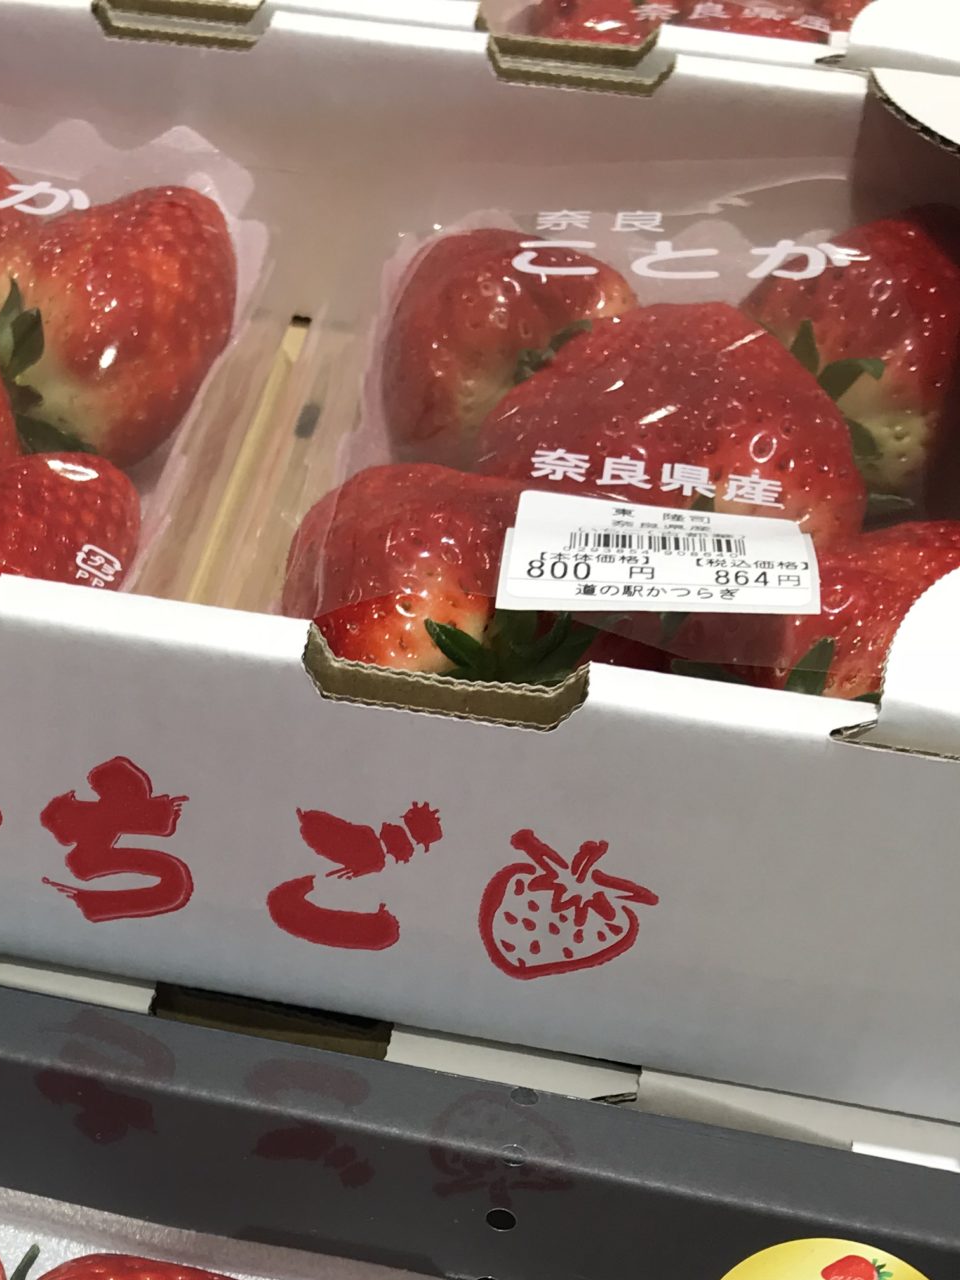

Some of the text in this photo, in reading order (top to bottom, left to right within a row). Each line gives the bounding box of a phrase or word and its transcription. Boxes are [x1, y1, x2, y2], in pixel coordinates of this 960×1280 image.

[536, 209, 665, 233] 奈良
[511, 239, 855, 281] ことか
[530, 448, 786, 510] 奈良県産
[526, 558, 592, 580] 800
[628, 566, 656, 581] 円
[695, 558, 810, 572] 【税込価格】
[575, 583, 740, 601] 道の駅かつらぎ
